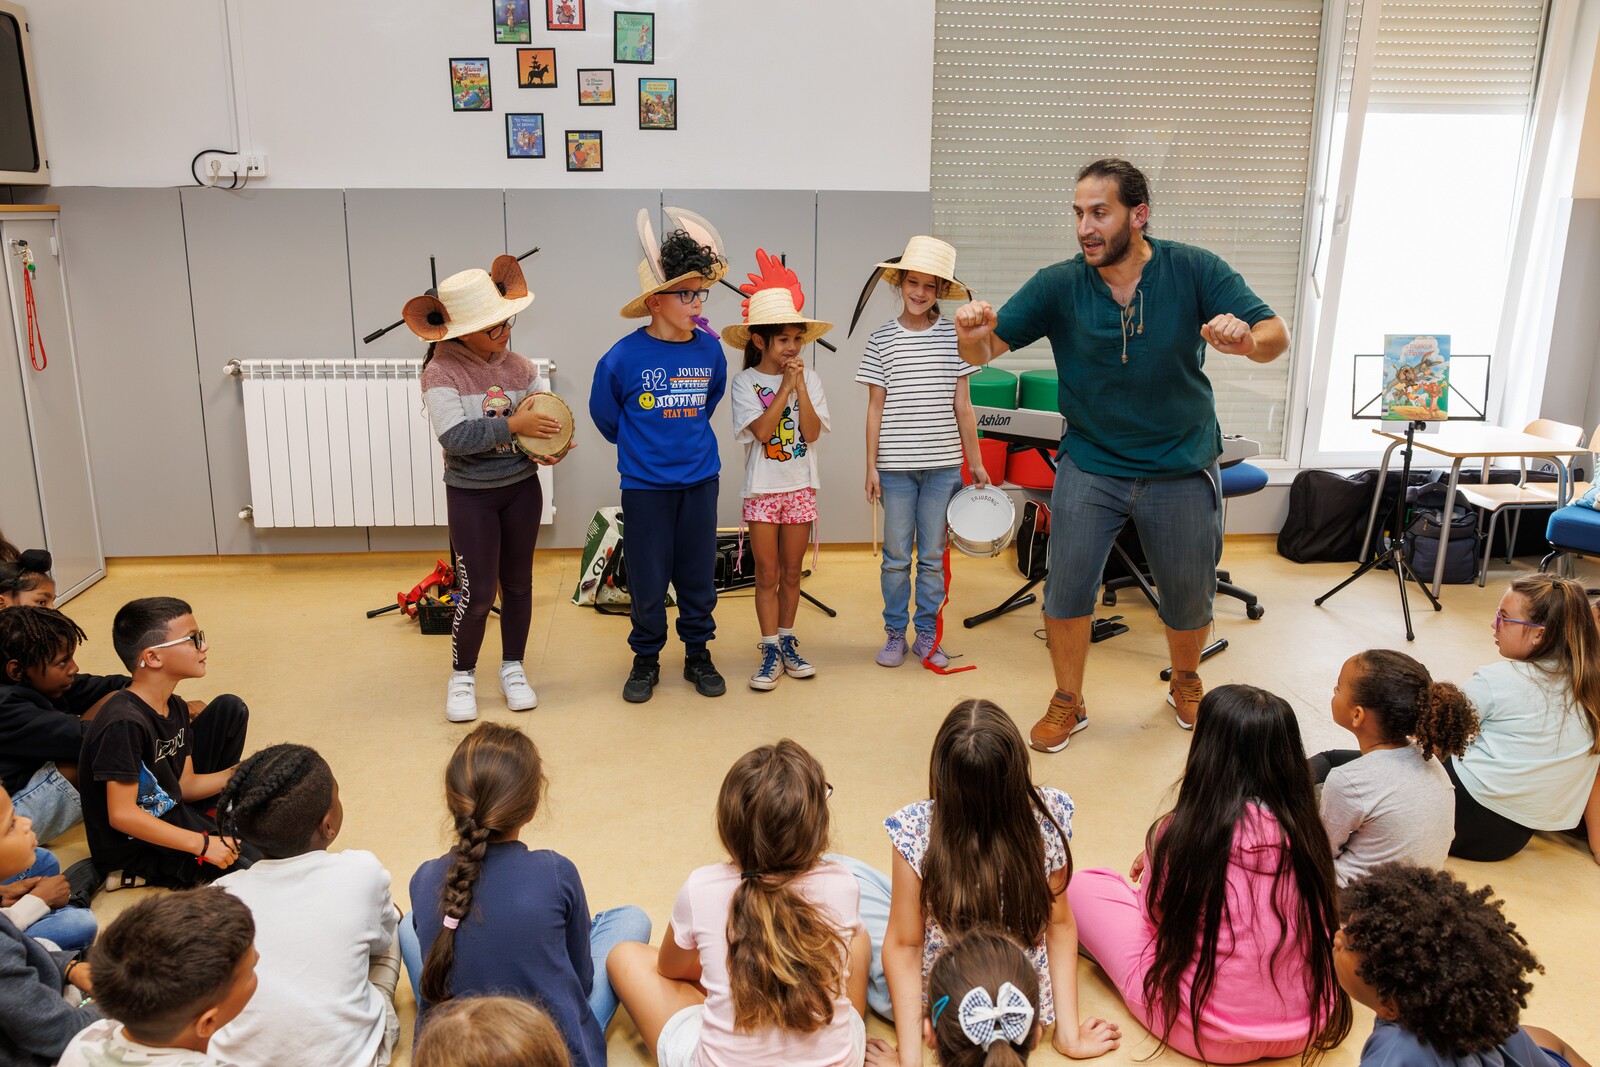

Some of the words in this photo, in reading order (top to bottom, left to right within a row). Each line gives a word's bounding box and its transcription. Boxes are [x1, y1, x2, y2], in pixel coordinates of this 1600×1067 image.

[677, 367, 713, 377] JOURNEY
[641, 367, 668, 392] 32
[663, 408, 681, 419] STAY
[977, 414, 1011, 426] Ashton
